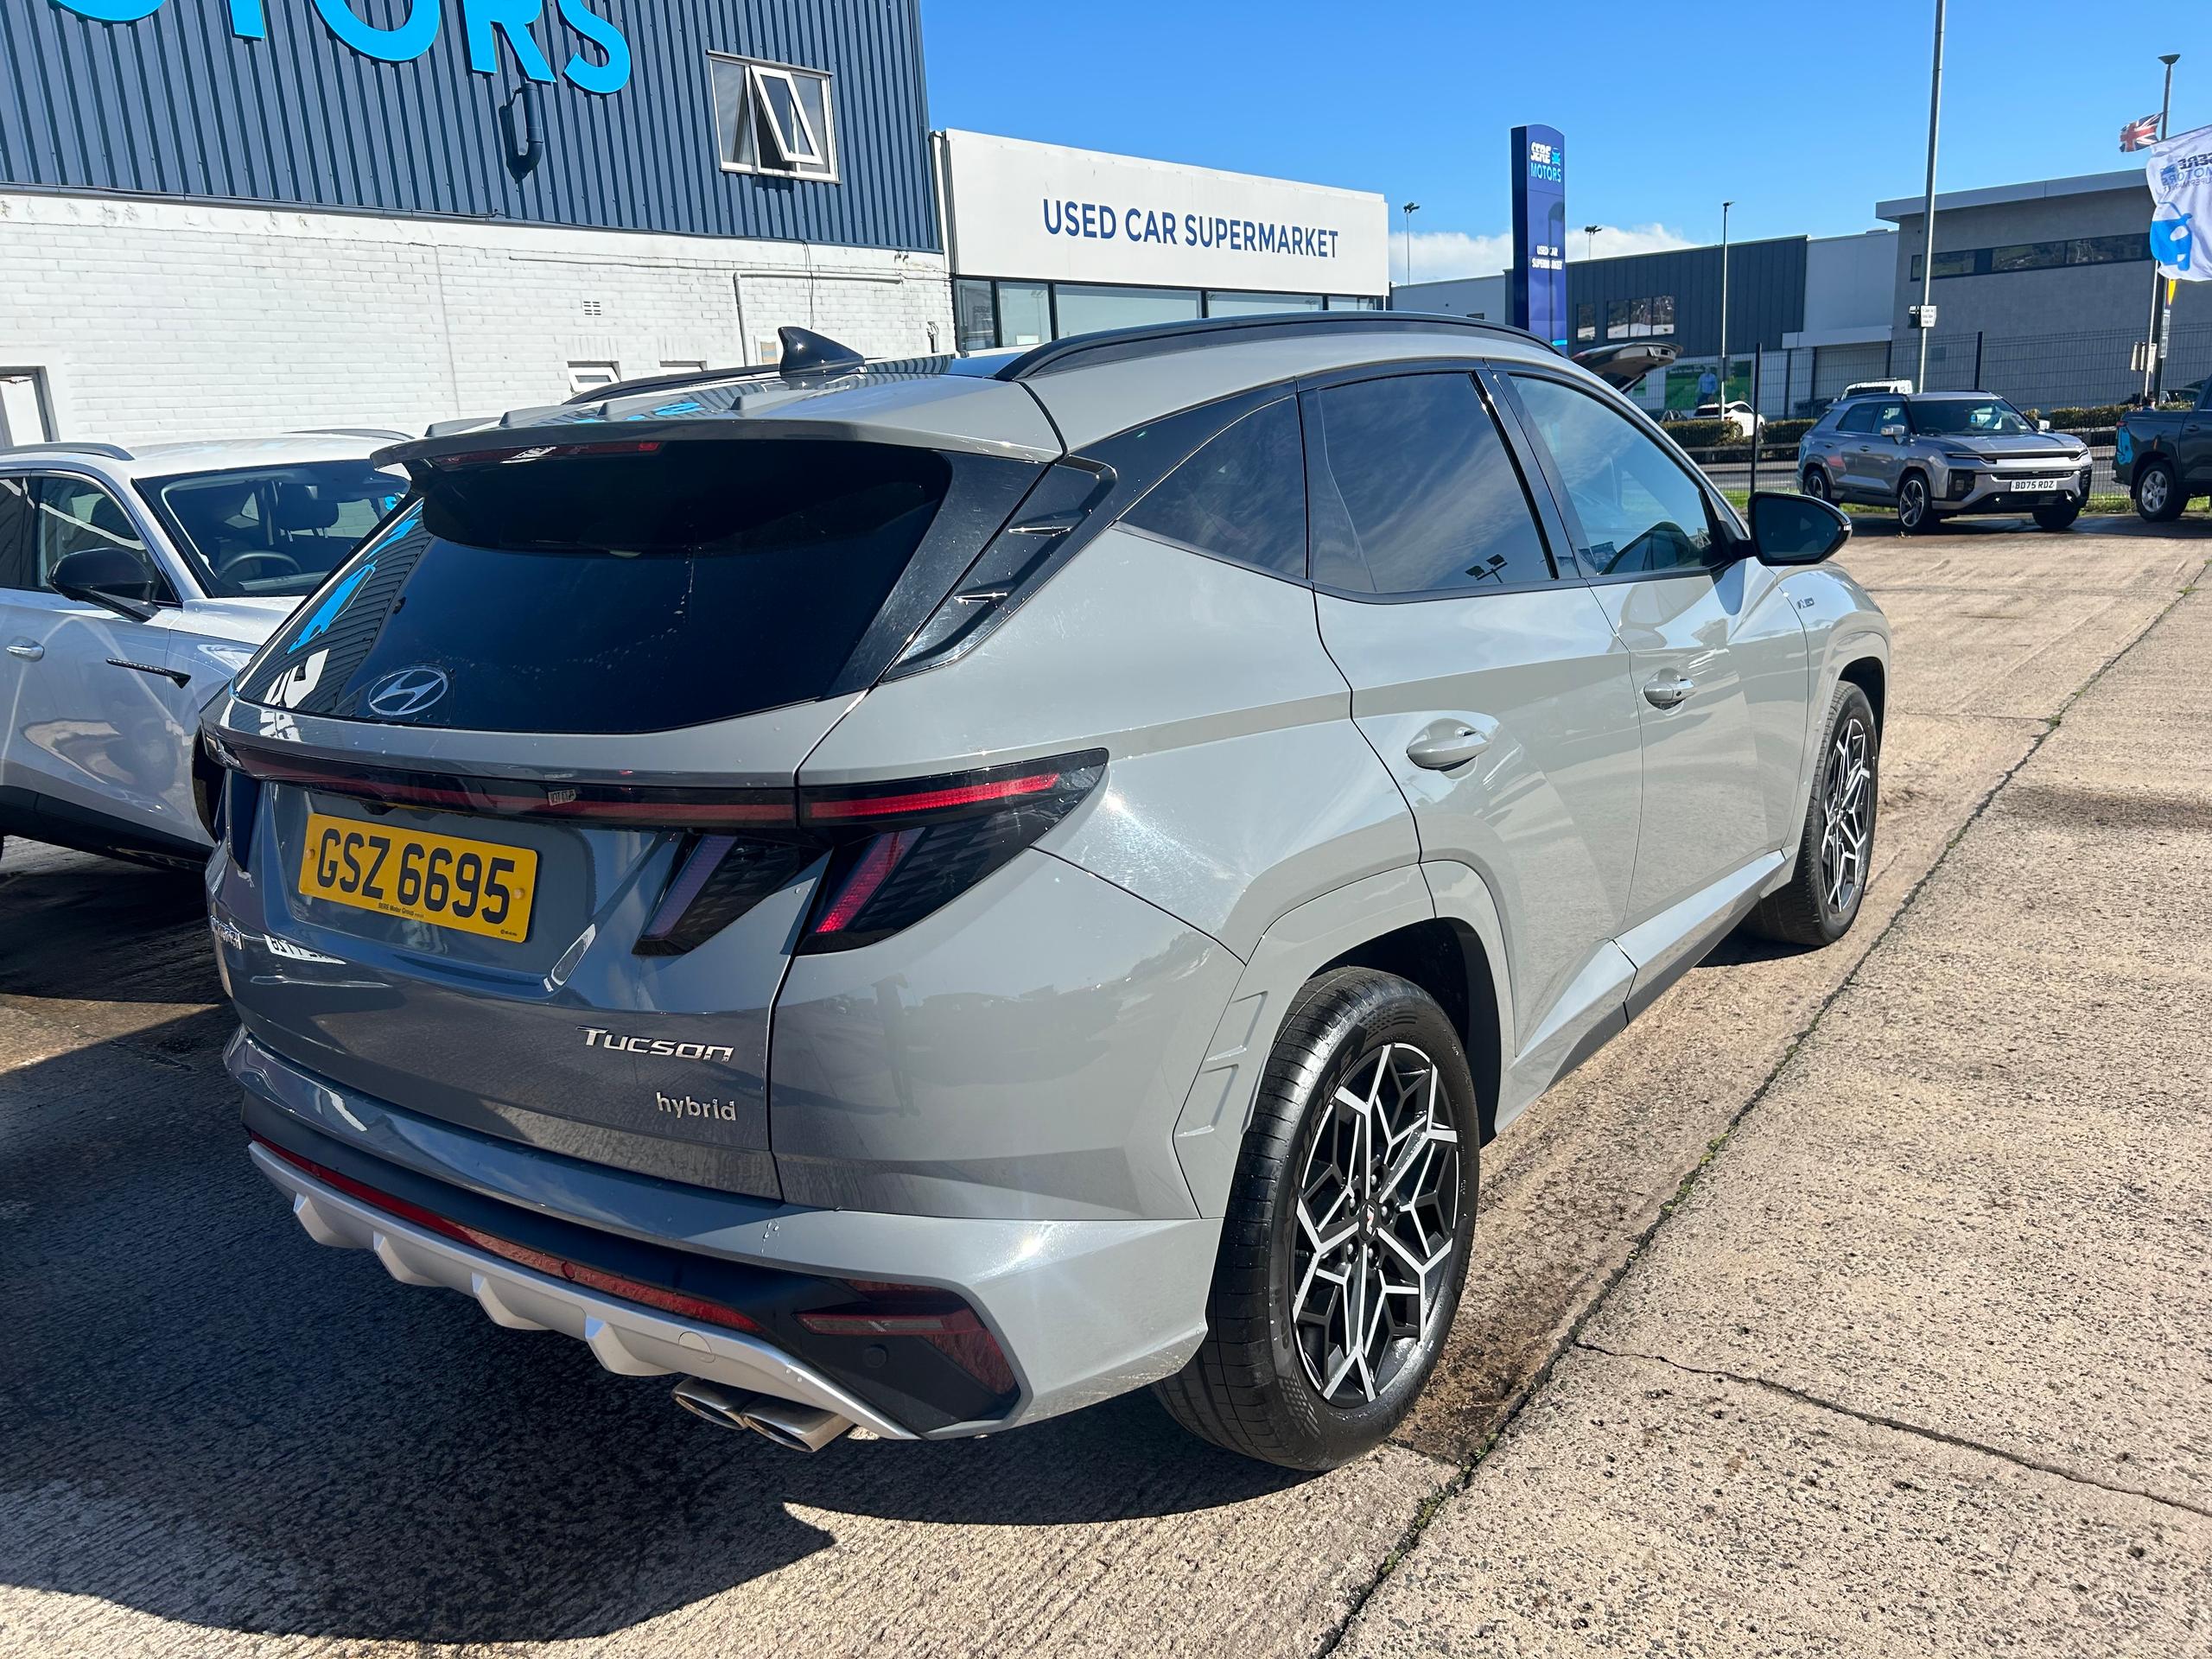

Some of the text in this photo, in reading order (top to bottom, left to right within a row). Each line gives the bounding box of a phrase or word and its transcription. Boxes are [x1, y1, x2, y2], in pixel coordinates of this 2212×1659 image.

[1530, 162, 1561, 183] MOTORS
[1043, 198, 1338, 258] USED CAR SUPERMARKET
[2014, 480, 2055, 490] BD75 RDZ
[316, 828, 516, 925] GSZ 6695
[655, 1091, 737, 1122] hybrid
